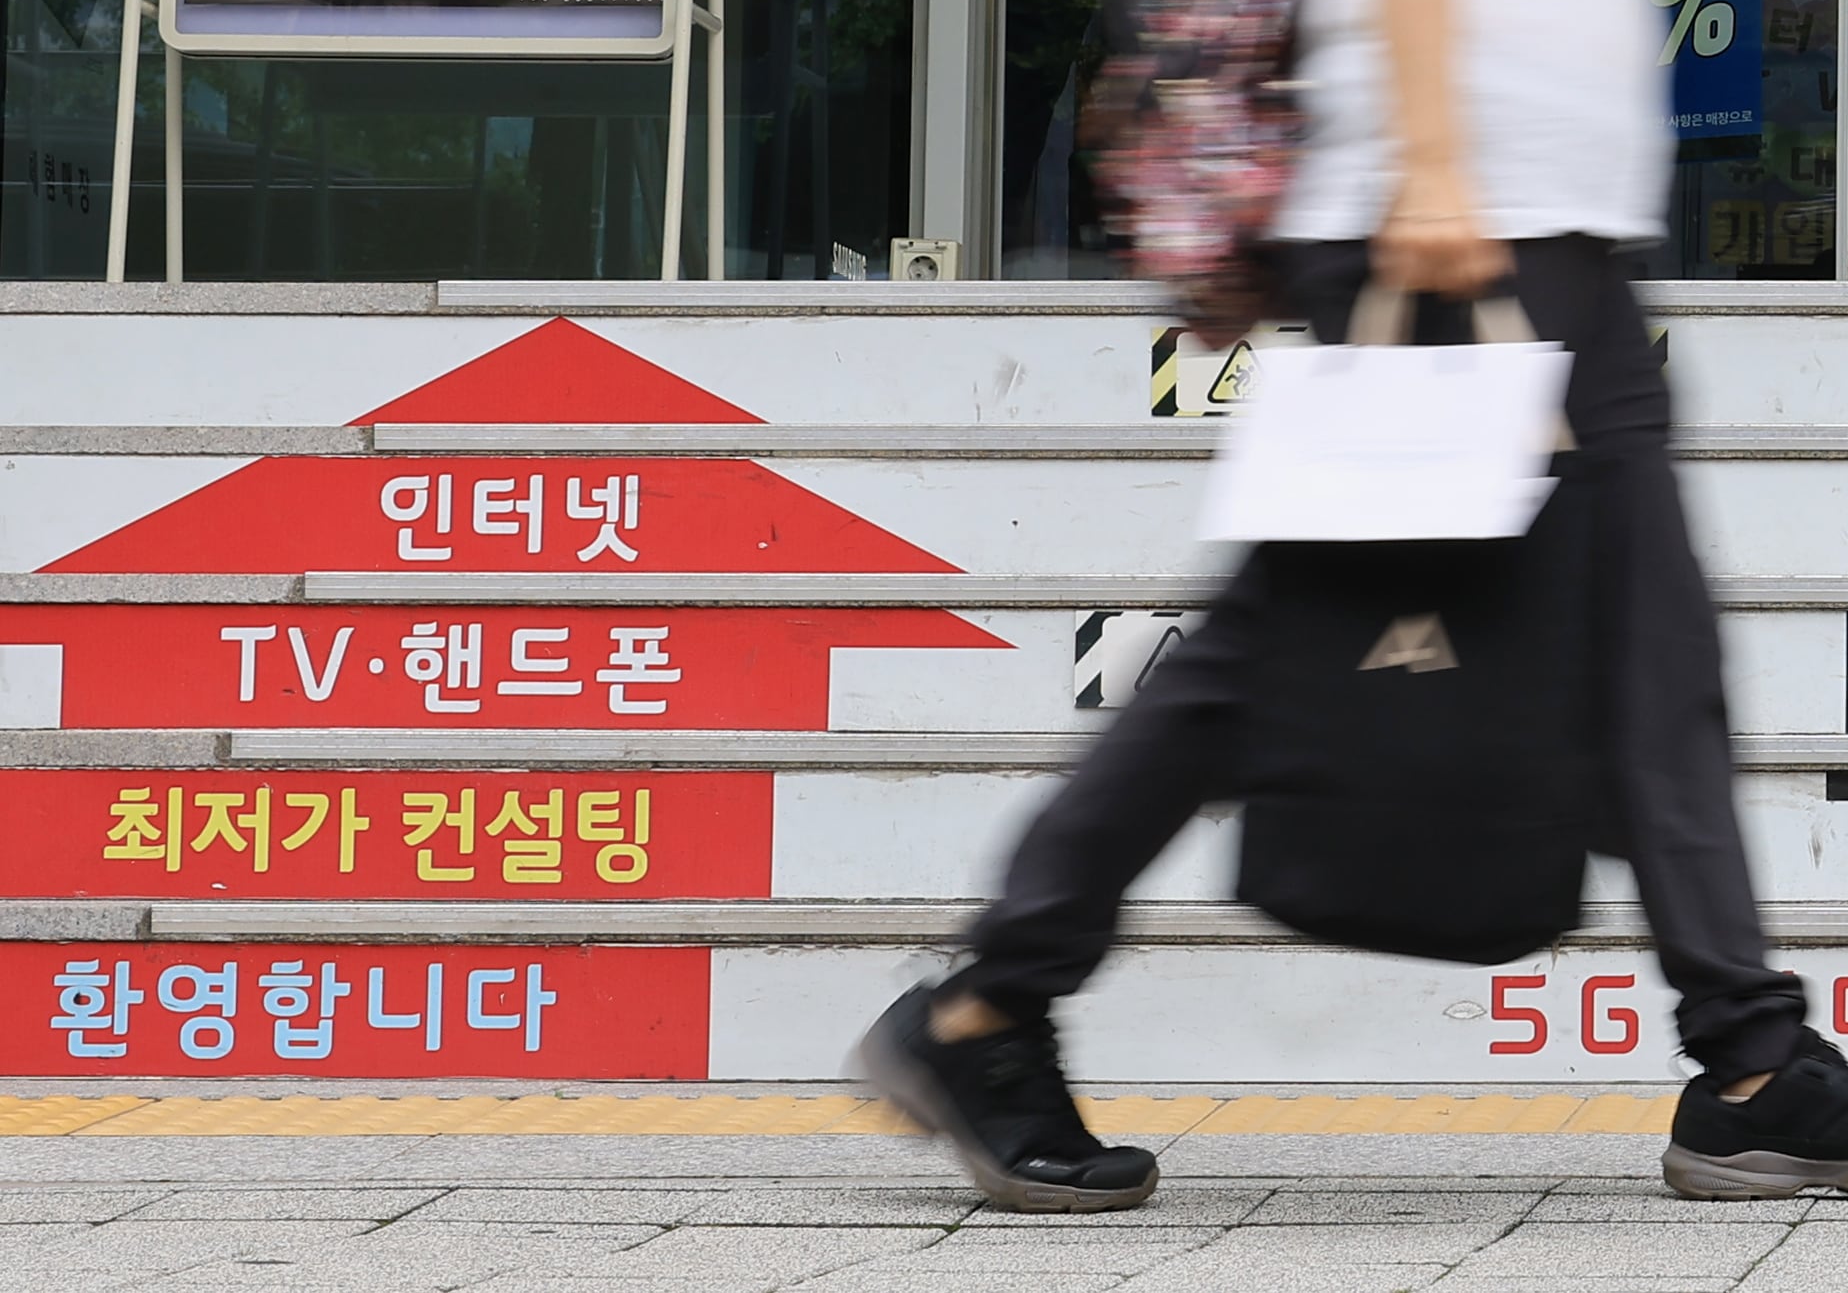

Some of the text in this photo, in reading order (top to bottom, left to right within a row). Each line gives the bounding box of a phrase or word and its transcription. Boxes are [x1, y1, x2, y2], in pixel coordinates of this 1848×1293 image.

[1705, 110, 1753, 126] 매장으로
[379, 472, 642, 564] 인터넷
[102, 786, 654, 884] 최저가 컨설팅
[49, 957, 558, 1061] 환영합니다
[1487, 973, 1642, 1057] 5G
